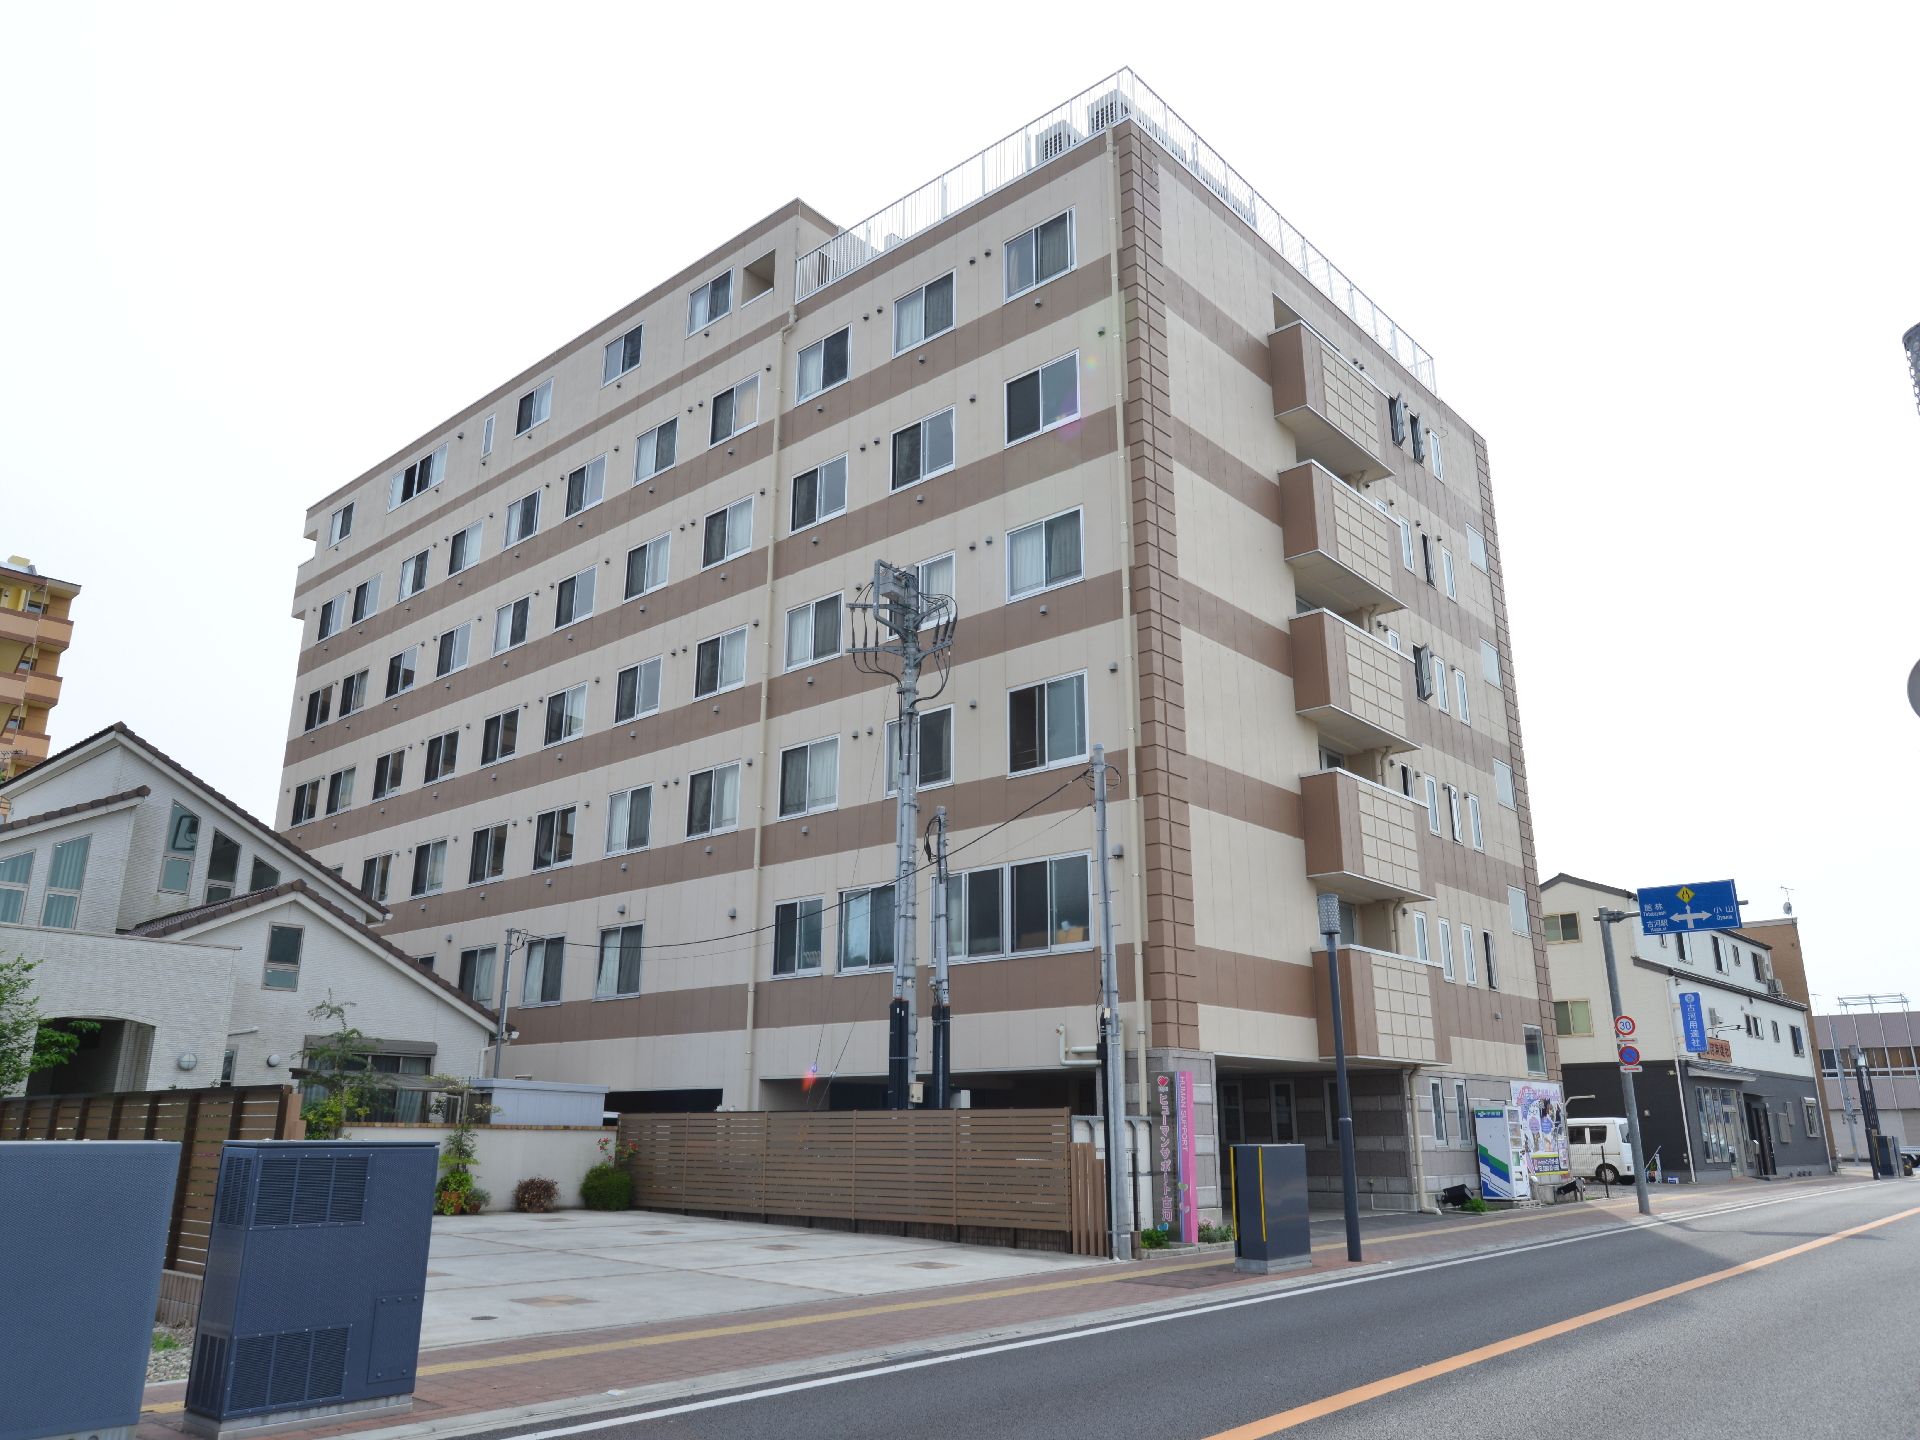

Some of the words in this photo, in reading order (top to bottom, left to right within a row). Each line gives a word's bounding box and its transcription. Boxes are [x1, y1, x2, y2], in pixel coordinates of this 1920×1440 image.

[1713, 905, 1734, 913] 小山
[1646, 919, 1669, 928] 古河駅
[1619, 1021, 1632, 1031] 30
[1179, 1076, 1187, 1109] HUMAN
[1180, 1110, 1188, 1152] SUPPORT
[1159, 1093, 1172, 1222] ヒューマンサポート古河
